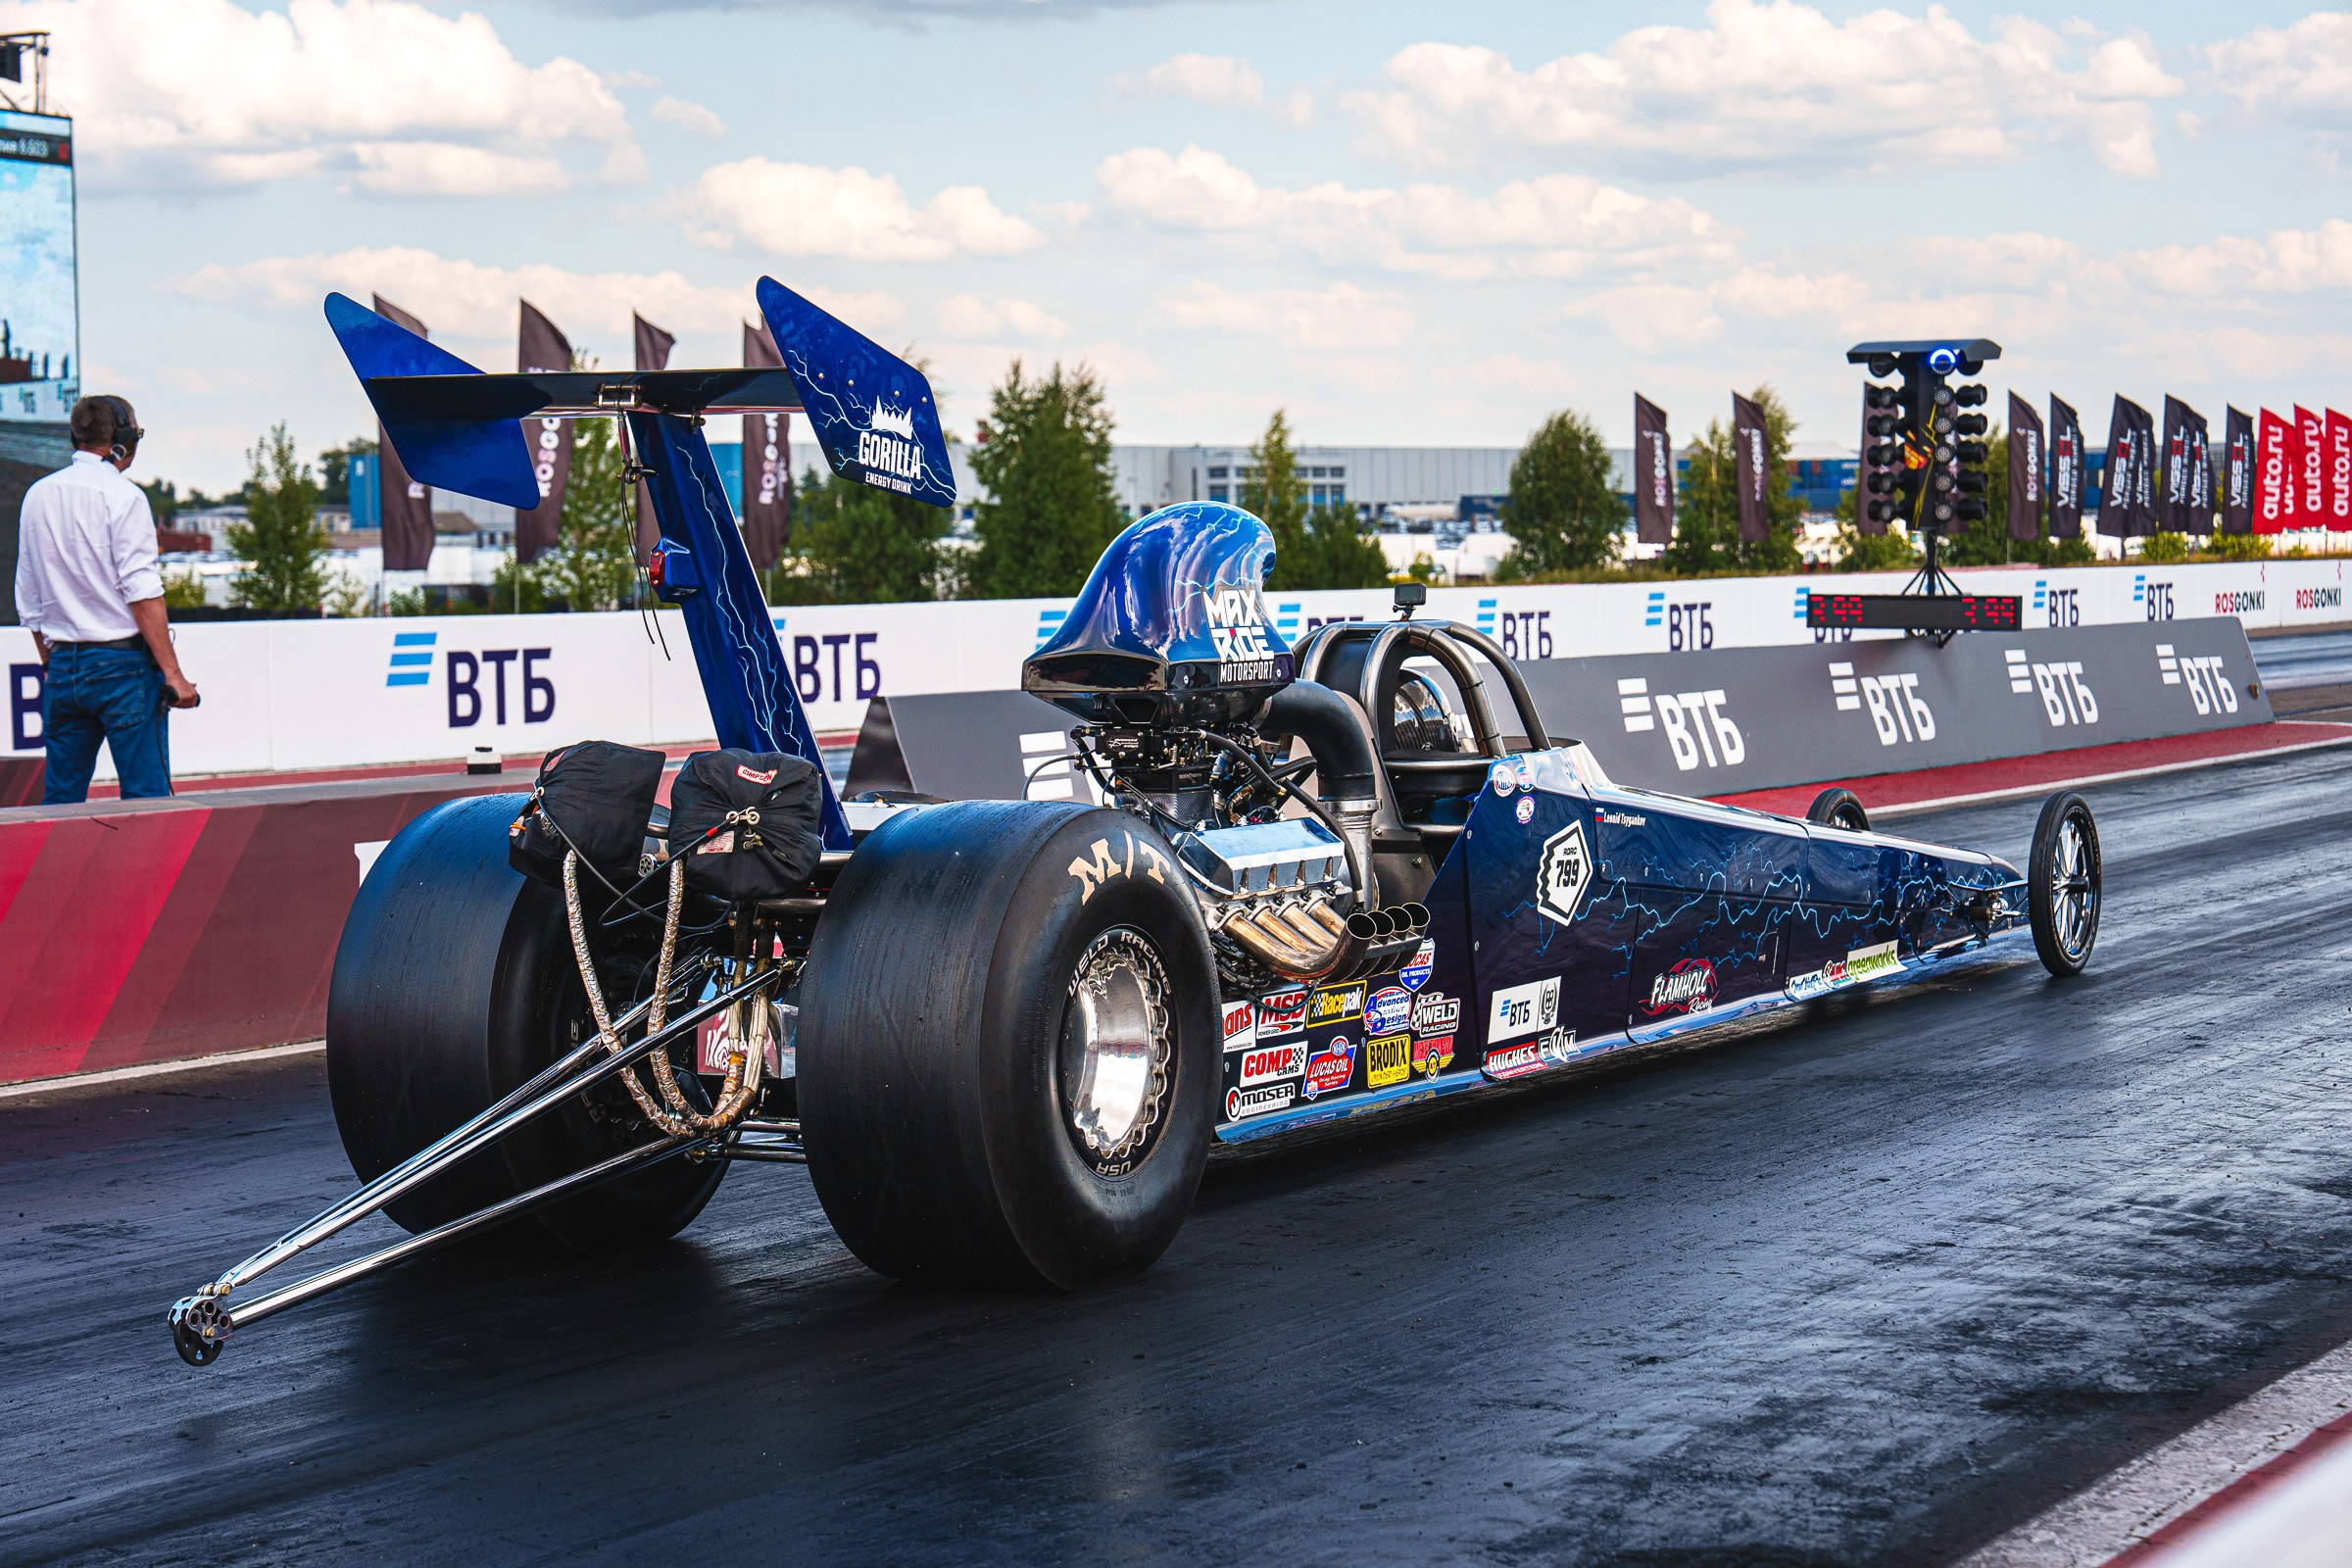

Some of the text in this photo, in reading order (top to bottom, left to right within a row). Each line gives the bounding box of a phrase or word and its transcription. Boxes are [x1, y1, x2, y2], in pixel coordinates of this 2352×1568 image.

[758, 414, 779, 506] ROSGON
[858, 431, 921, 480] GORILLA
[2263, 424, 2283, 519] auto.ru
[2303, 419, 2322, 512] auto.ru
[2332, 426, 2351, 516] auto.ru
[865, 470, 912, 495] ENERGY DRINK
[1202, 589, 1263, 628] MAX
[2048, 589, 2079, 627] ВТБ
[2147, 582, 2174, 621] ВТБ
[2215, 591, 2265, 613] ROSGONKI
[2296, 587, 2341, 609] ROSGONKI
[1502, 612, 1552, 661] ВТБ
[1669, 603, 1714, 652] ВТБ
[1210, 626, 1274, 662] RIDE
[794, 632, 881, 704] ВТБ
[1220, 661, 1274, 683] MOTORSPORT
[446, 648, 557, 728] ВТБ
[2033, 662, 2098, 727] ВТБ
[2180, 656, 2237, 715] ВТБ
[1860, 672, 1936, 746] ВТБ
[1655, 689, 1745, 771] ВТБ
[742, 768, 773, 782] SIMPSN
[1603, 811, 1646, 827] Leonid Tsygankov
[1068, 829, 1171, 906] M/T
[1556, 858, 1581, 888] 799
[1068, 931, 1172, 997] WELD RACING
[1405, 952, 1432, 968] UCAS
[1409, 968, 1431, 977] PRODUCTS
[1847, 945, 1898, 979] greenworks
[1261, 993, 1307, 1025] MSD
[1321, 986, 1362, 1017] Racepak
[1422, 1003, 1458, 1025] WELD
[1509, 1000, 1531, 1027] ВТБ
[1689, 997, 1713, 1014] Racing
[1223, 1003, 1252, 1039] ans
[1422, 1021, 1456, 1033] RACING
[1245, 1048, 1293, 1077] COMP
[1277, 1063, 1299, 1076] CAMS
[1309, 1058, 1349, 1079] LUCAS OIL
[1370, 1038, 1407, 1072] BRODIX
[1490, 1045, 1536, 1072] HUGHES
[1496, 1062, 1544, 1079] CONVERTERS
[1242, 1085, 1294, 1107] MOSER
[1242, 1100, 1289, 1115] ENGINEERING
[1096, 1160, 1131, 1176] USA
